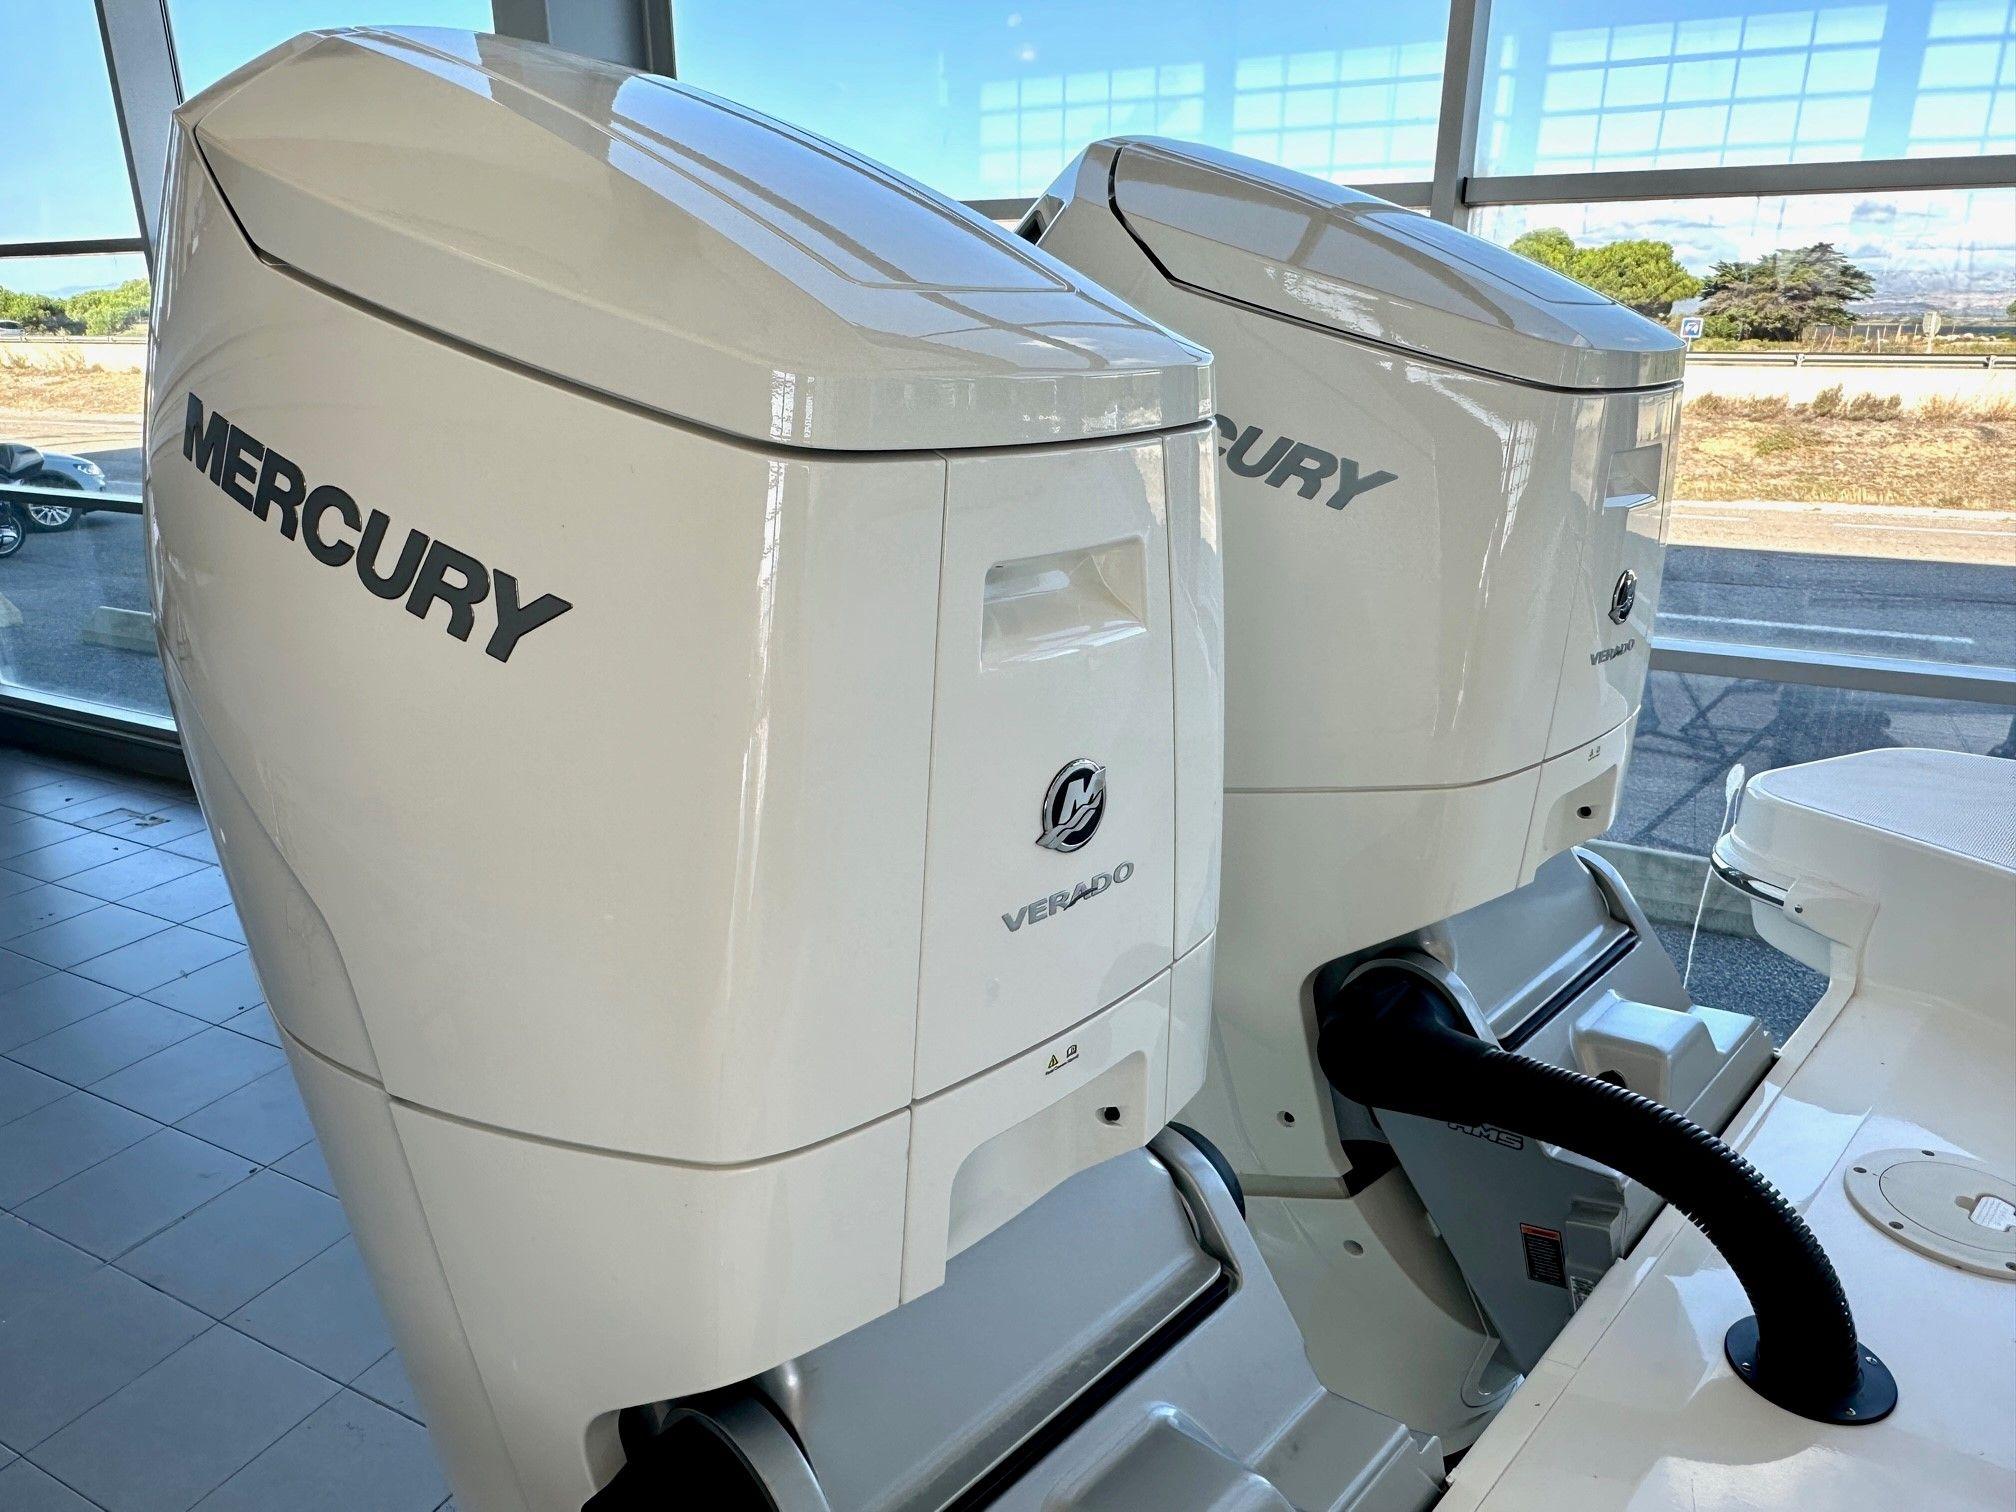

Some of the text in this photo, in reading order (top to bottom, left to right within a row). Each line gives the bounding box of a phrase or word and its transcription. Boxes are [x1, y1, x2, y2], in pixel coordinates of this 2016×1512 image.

[1214, 414, 1399, 510] URY
[183, 392, 573, 663] MERCURY
[1001, 861, 1135, 932] VERADO
